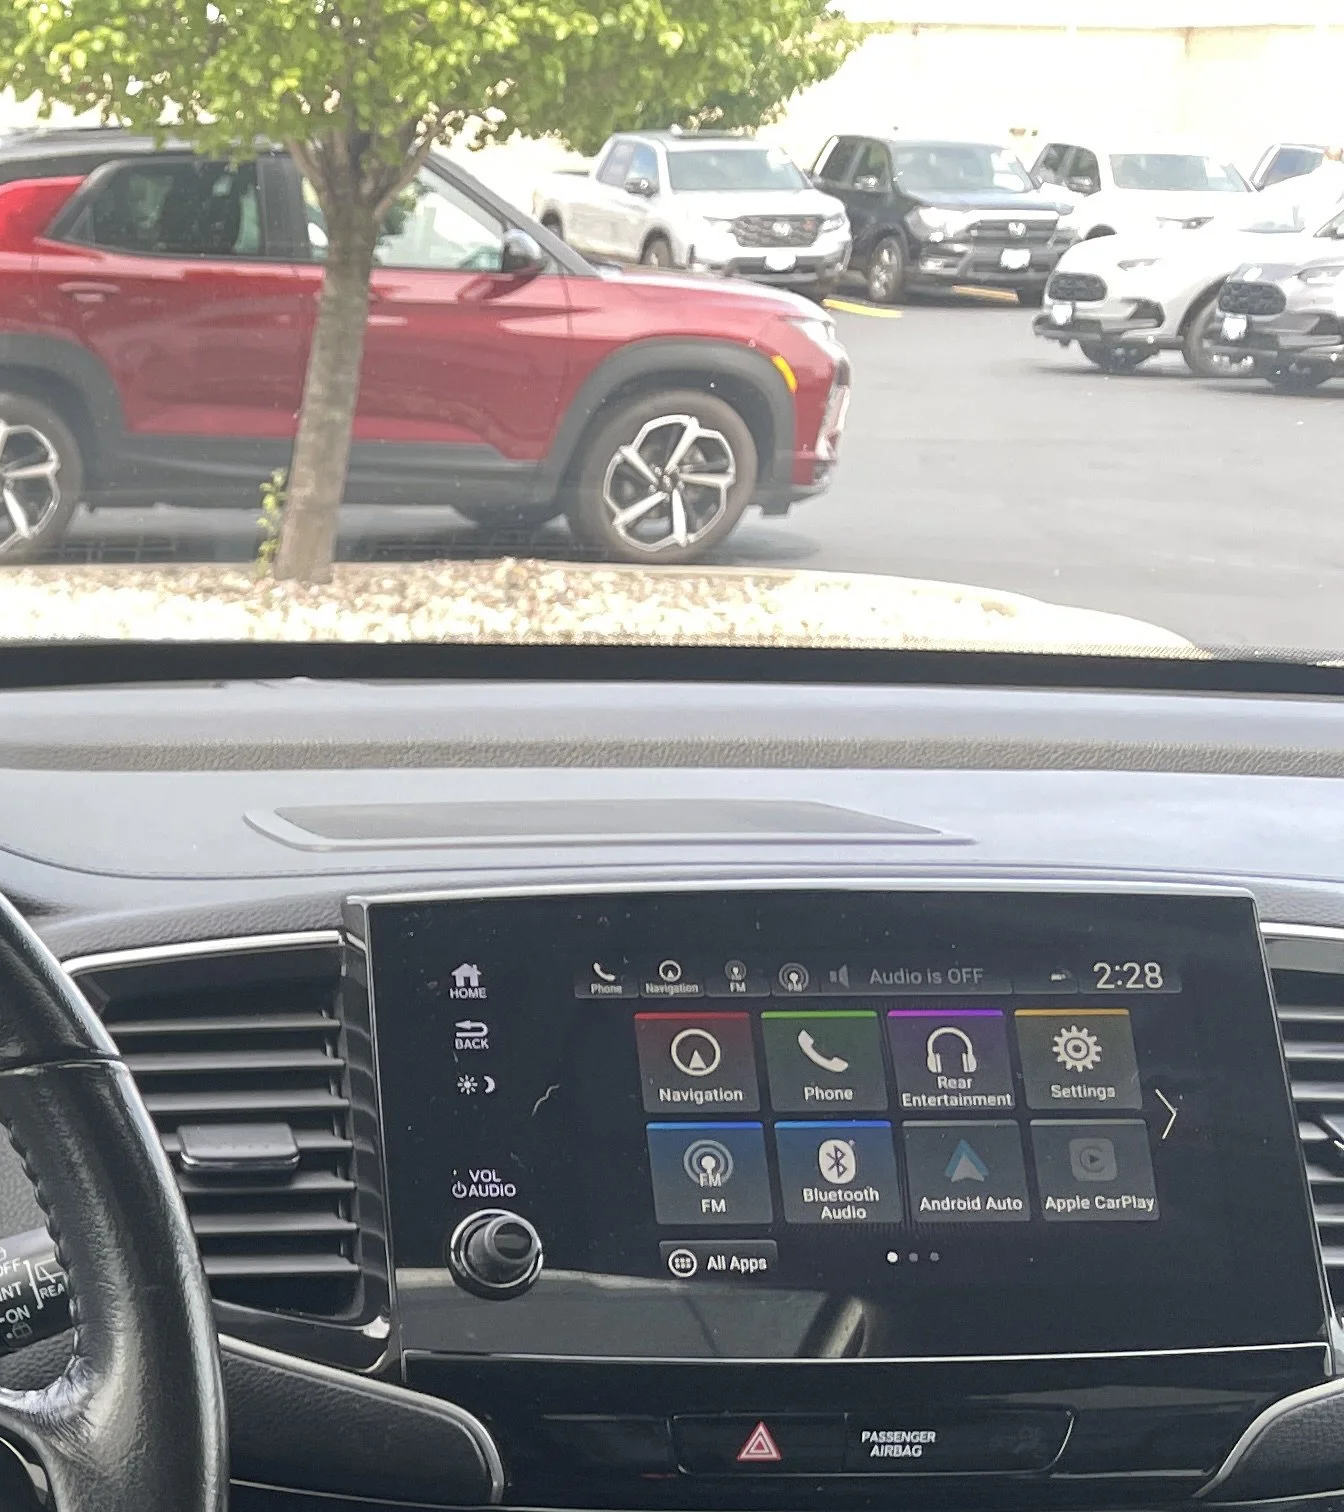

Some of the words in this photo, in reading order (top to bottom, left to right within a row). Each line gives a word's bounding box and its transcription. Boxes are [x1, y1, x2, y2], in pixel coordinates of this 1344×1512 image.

[870, 967, 921, 986] Audio
[927, 967, 943, 985] is
[947, 967, 984, 985] OFF
[1093, 962, 1163, 988] 2:28
[449, 987, 487, 999] HOME
[590, 983, 623, 994] Phone
[645, 982, 699, 996] Navigation
[730, 982, 746, 993] FM
[455, 1037, 490, 1050] BACK
[937, 1076, 973, 1090] Rear
[659, 1087, 744, 1105] Navigation
[804, 1086, 854, 1102] Phone
[902, 1092, 1013, 1108] Entertainment
[1050, 1084, 1116, 1101] Settings
[468, 1169, 502, 1183] VOL
[699, 1173, 722, 1188] FM
[468, 1183, 517, 1198] AUDIO
[802, 1187, 880, 1203] Bluetooth
[701, 1199, 727, 1213] FM
[919, 1196, 981, 1212] Android
[985, 1196, 1024, 1212] Auto
[1045, 1196, 1091, 1213] Apple
[1094, 1195, 1154, 1212] CarPlay
[820, 1206, 867, 1221] Audio
[707, 1255, 726, 1272] All
[729, 1256, 767, 1275] Apps
[39, 1283, 67, 1301] REA
[6, 1304, 31, 1324] ON
[861, 1430, 937, 1444] PASSENGER
[870, 1443, 923, 1458] AIRBAG
